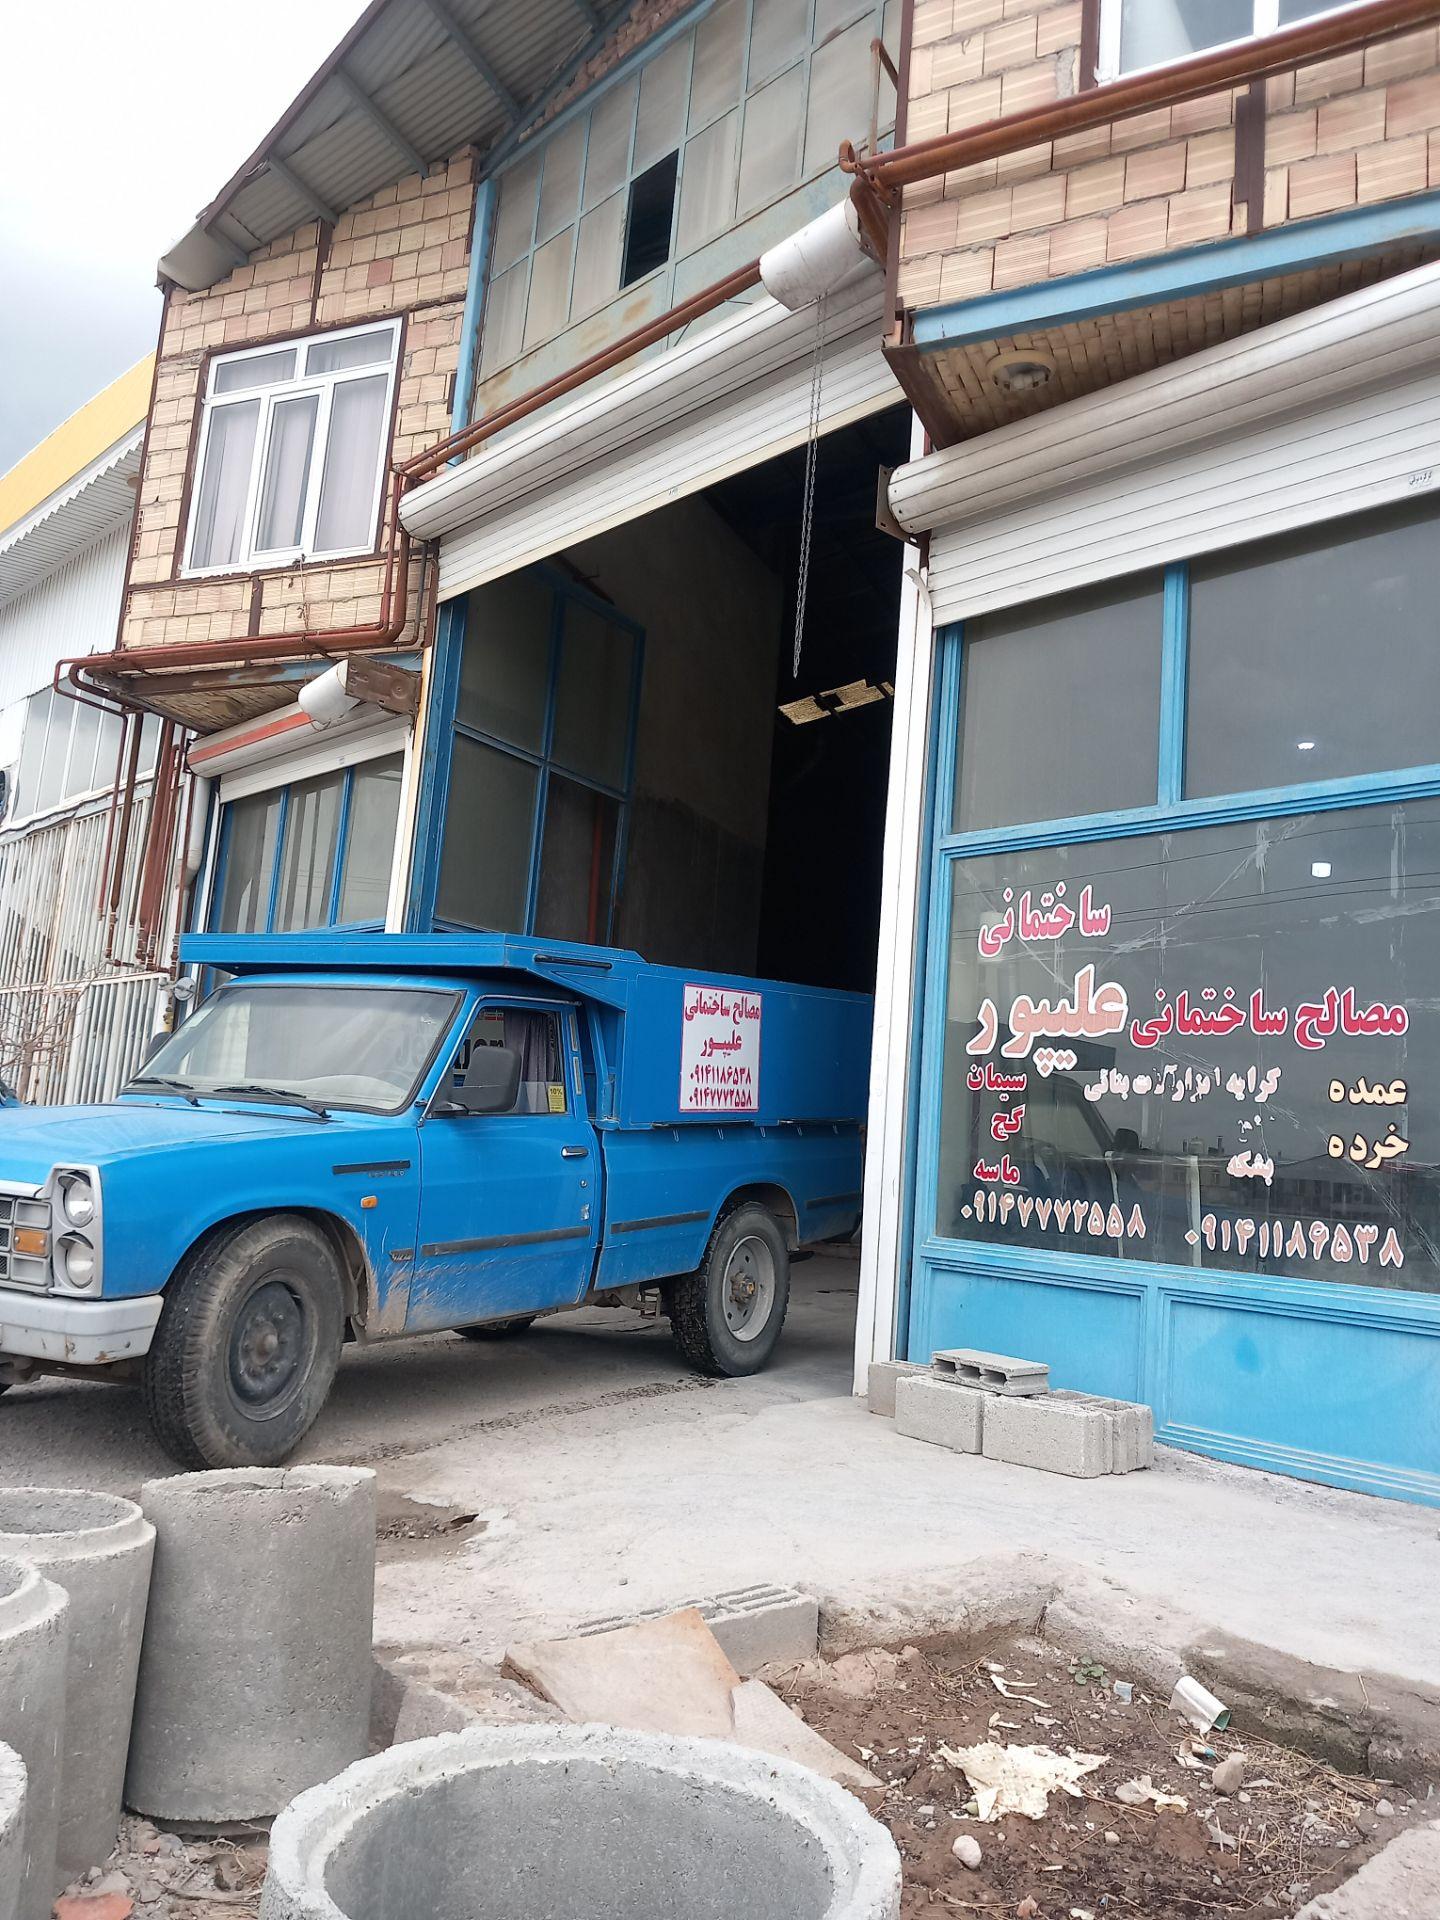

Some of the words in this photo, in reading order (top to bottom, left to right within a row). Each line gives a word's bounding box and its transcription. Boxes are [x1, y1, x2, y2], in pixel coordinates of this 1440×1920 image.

[978, 881, 1111, 957] ساختمانی
[684, 990, 730, 1021] ساختمانی
[732, 995, 760, 1025] مصالح
[966, 963, 1128, 1078] علیپور
[1130, 986, 1288, 1048] ساختمانی
[1294, 986, 1409, 1049] مصالح
[966, 1061, 1027, 1102] سیمان
[1225, 1065, 1282, 1103] کرایه
[1327, 1076, 1408, 1106] عمده
[991, 1103, 1026, 1141] گچ
[1327, 1122, 1410, 1169] خرده
[973, 1154, 1020, 1185] ماسه
[960, 1189, 1147, 1239] ۰۹۱۴۷۷۷۲۵۵۸
[1184, 1213, 1404, 1269] ۰۹۱۴۱۱۸۶۵۳۸
